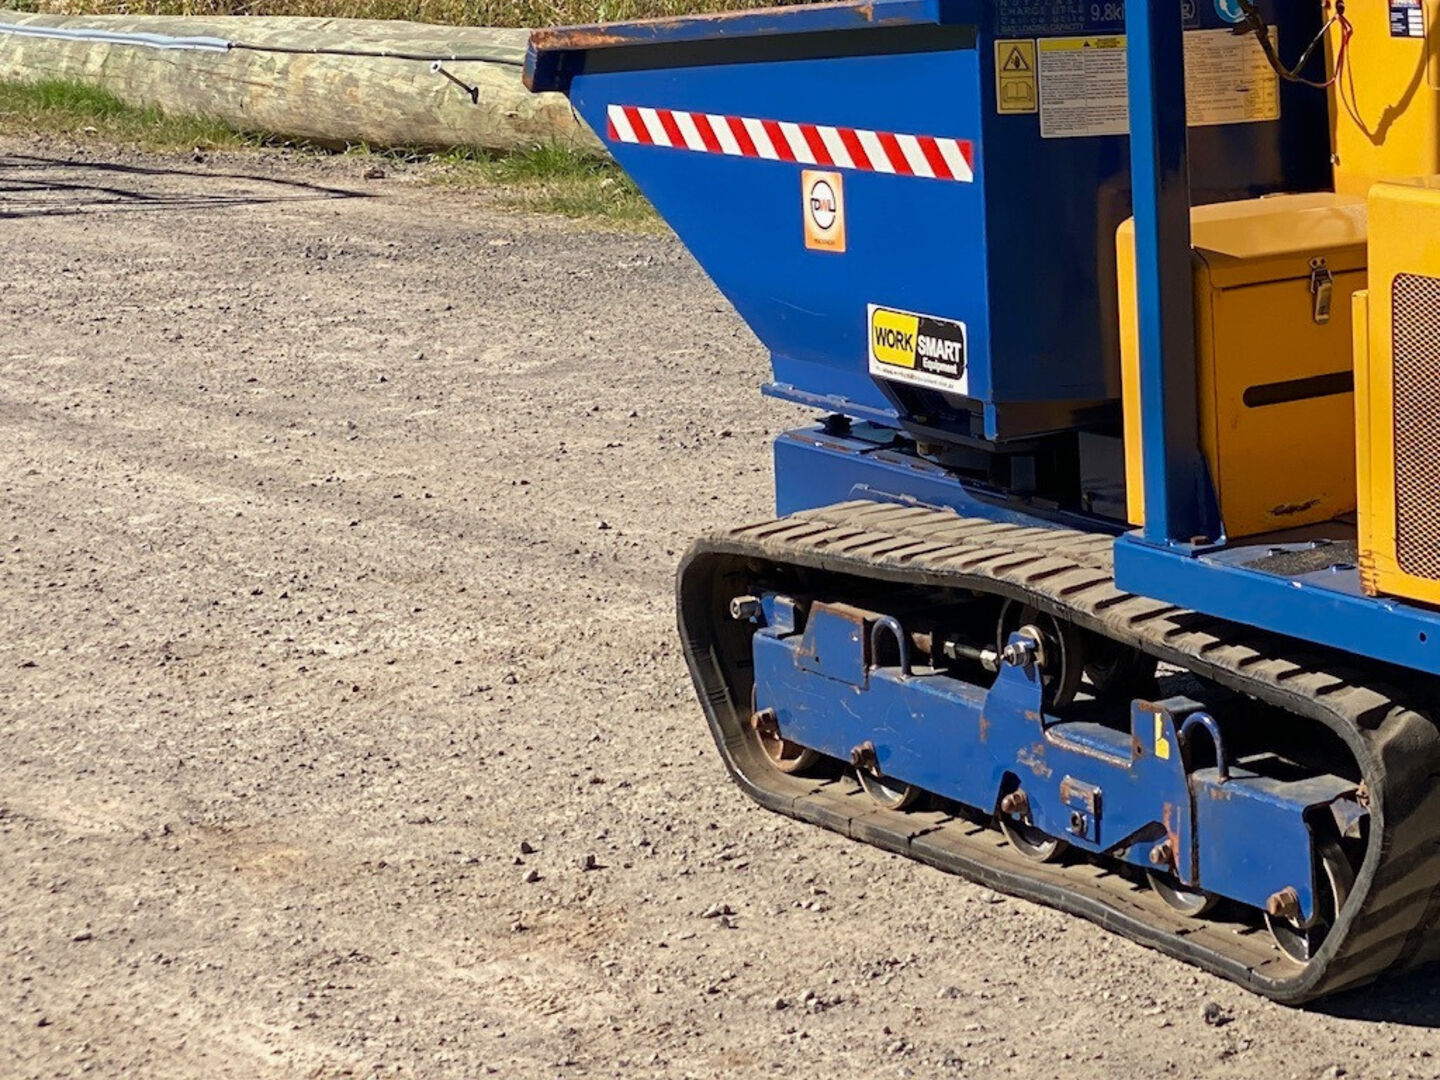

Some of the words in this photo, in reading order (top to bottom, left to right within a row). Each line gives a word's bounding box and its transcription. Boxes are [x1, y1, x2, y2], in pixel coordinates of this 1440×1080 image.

[1090, 2, 1125, 21] 9.8k
[874, 325, 914, 353] WORK
[917, 334, 962, 363] SMART
